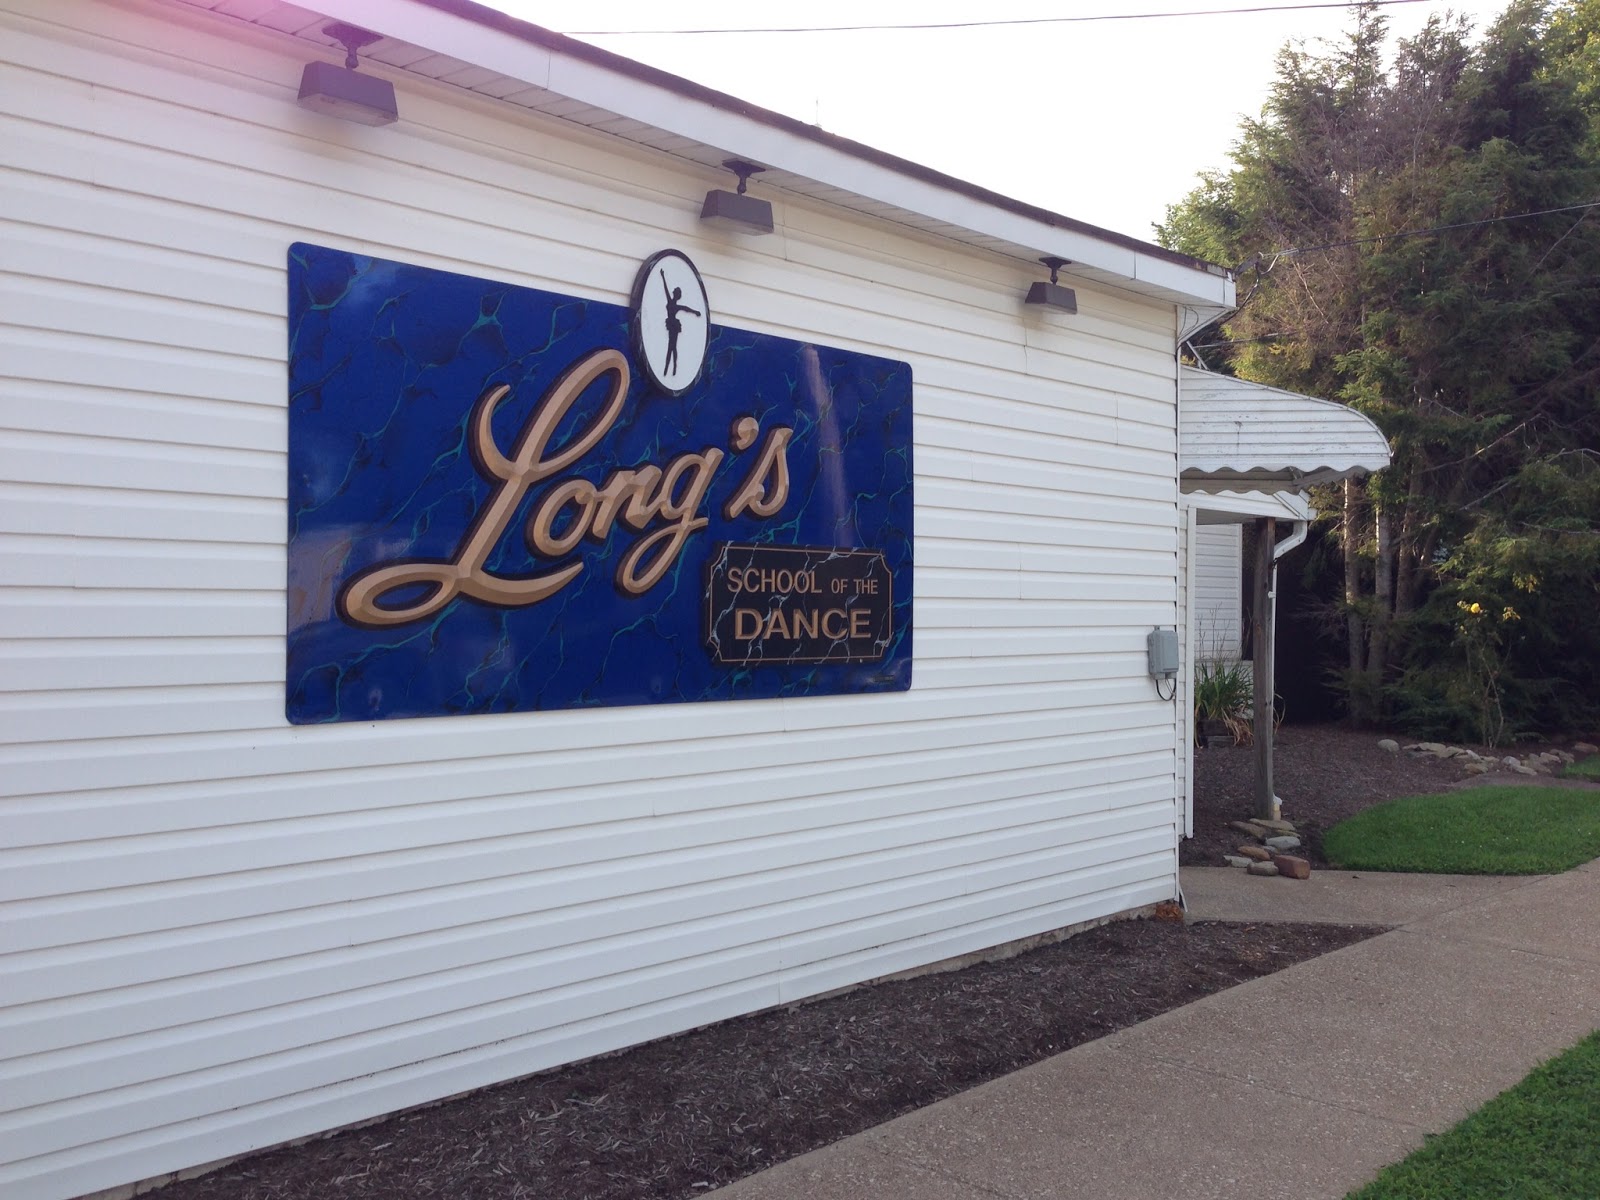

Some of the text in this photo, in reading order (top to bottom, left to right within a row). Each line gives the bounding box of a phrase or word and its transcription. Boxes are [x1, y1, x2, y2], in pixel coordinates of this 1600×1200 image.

[340, 347, 794, 625] Long's
[727, 566, 878, 595] SCHOOL OF THE
[735, 608, 871, 640] DANCE
